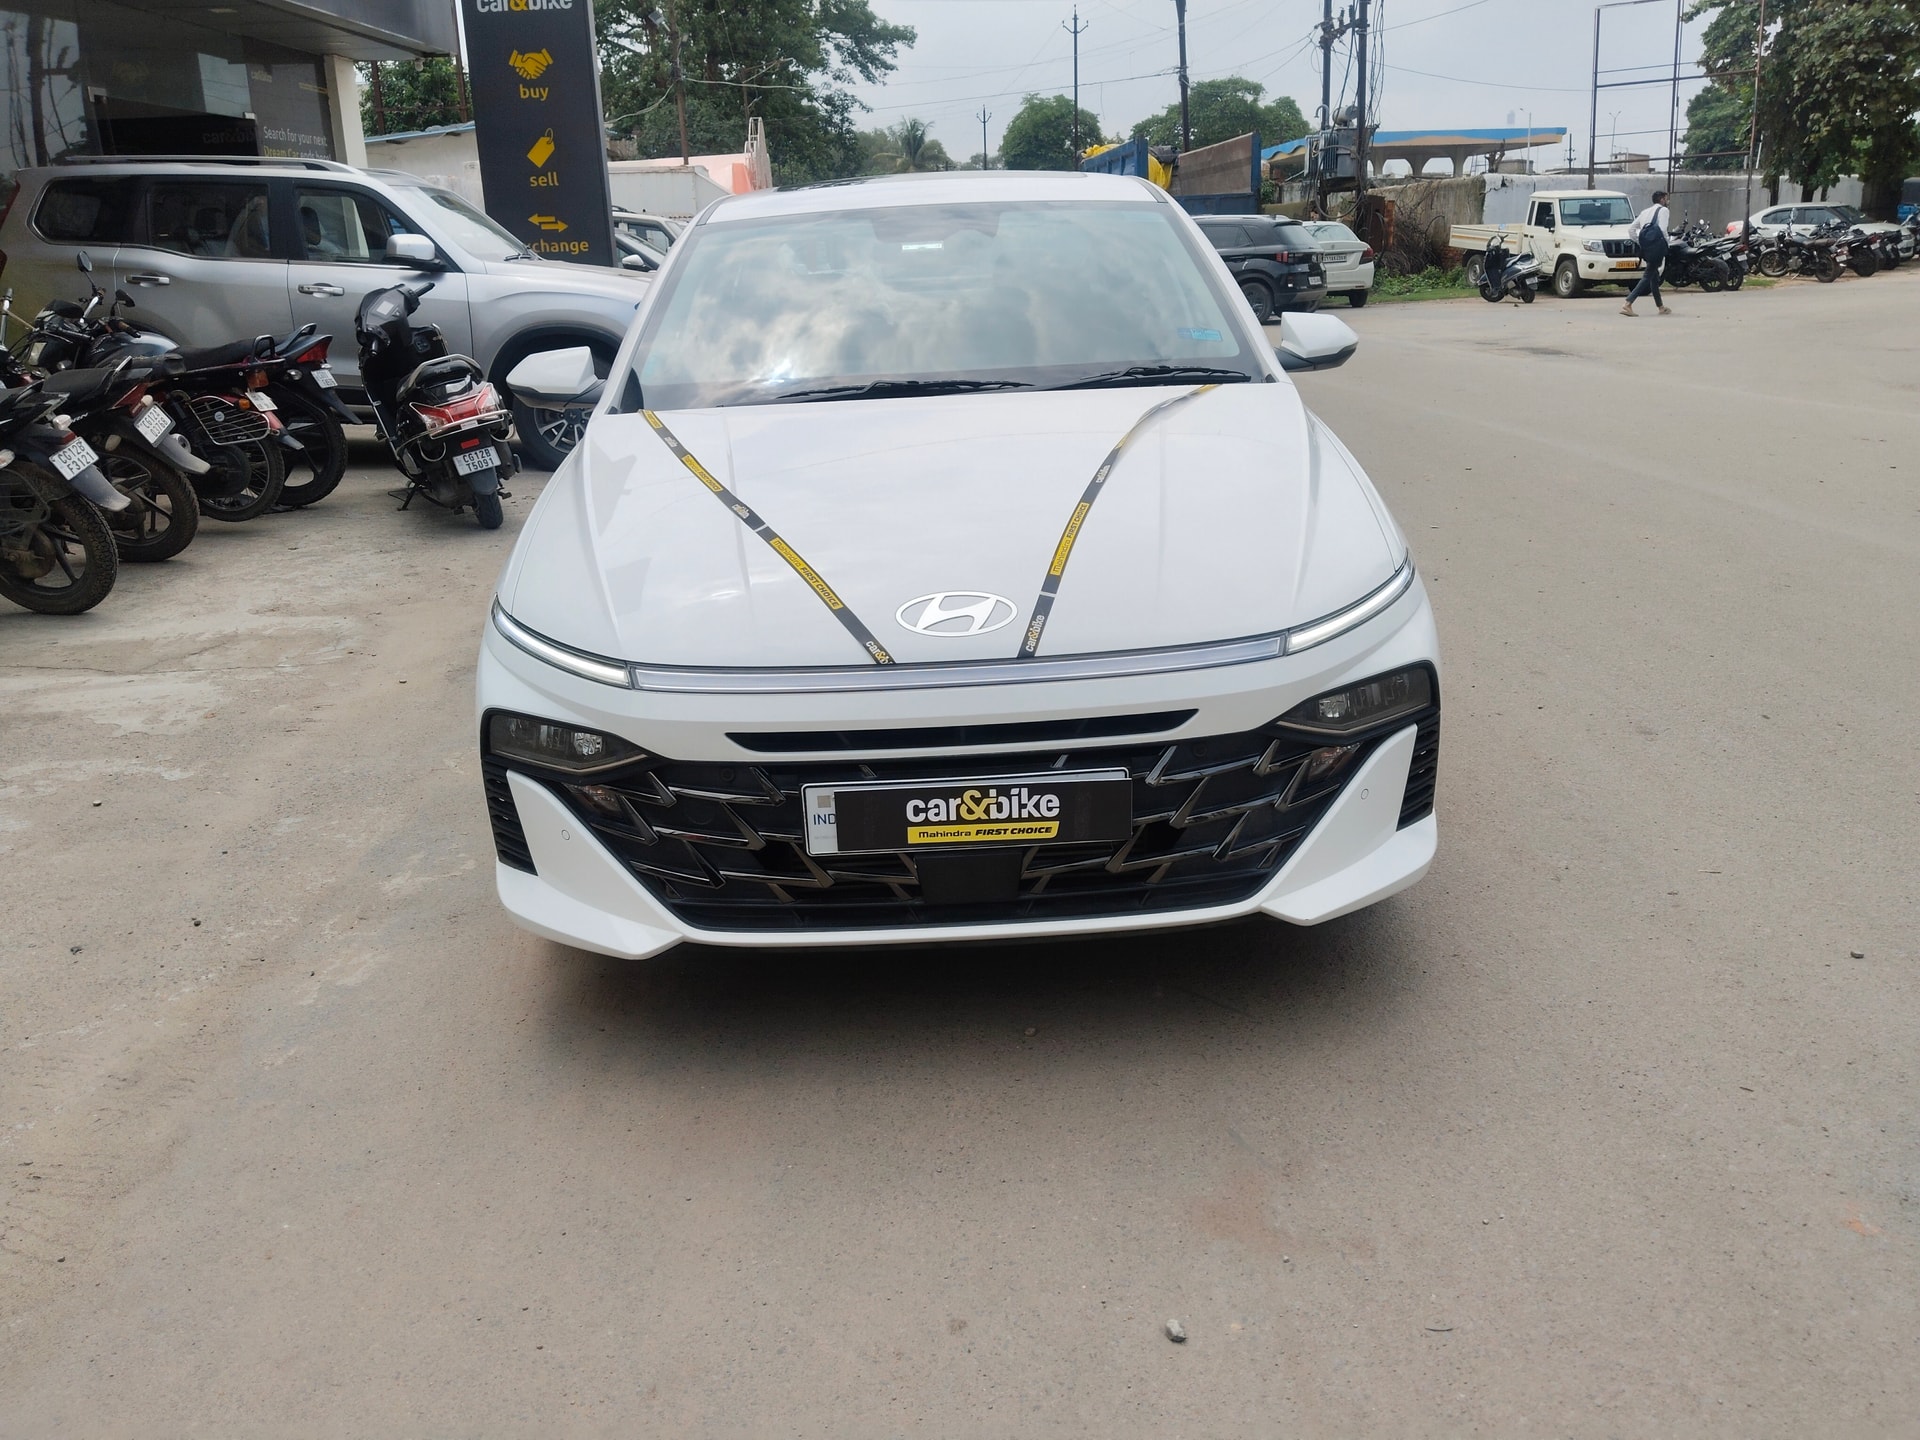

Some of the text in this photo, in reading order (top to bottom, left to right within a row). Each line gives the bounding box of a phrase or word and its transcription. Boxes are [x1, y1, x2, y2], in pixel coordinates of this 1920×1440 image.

[519, 84, 549, 100] buy
[263, 126, 287, 141] Search
[287, 129, 297, 143] for
[297, 133, 312, 145] your
[529, 172, 559, 187] sell
[57, 441, 86, 465] CG12B
[462, 448, 491, 463] CG12B
[67, 452, 95, 475] F3121
[465, 457, 494, 471] T5091
[1053, 504, 1087, 573] Mahindra FIRST CHOICE
[774, 540, 840, 607] Mahindra FIRST CHOICE
[1026, 614, 1045, 652] car&bike
[906, 787, 1061, 823] car&bike
[813, 813, 836, 826] IND
[918, 826, 1053, 838] Mahindra FIRST CHOICE
